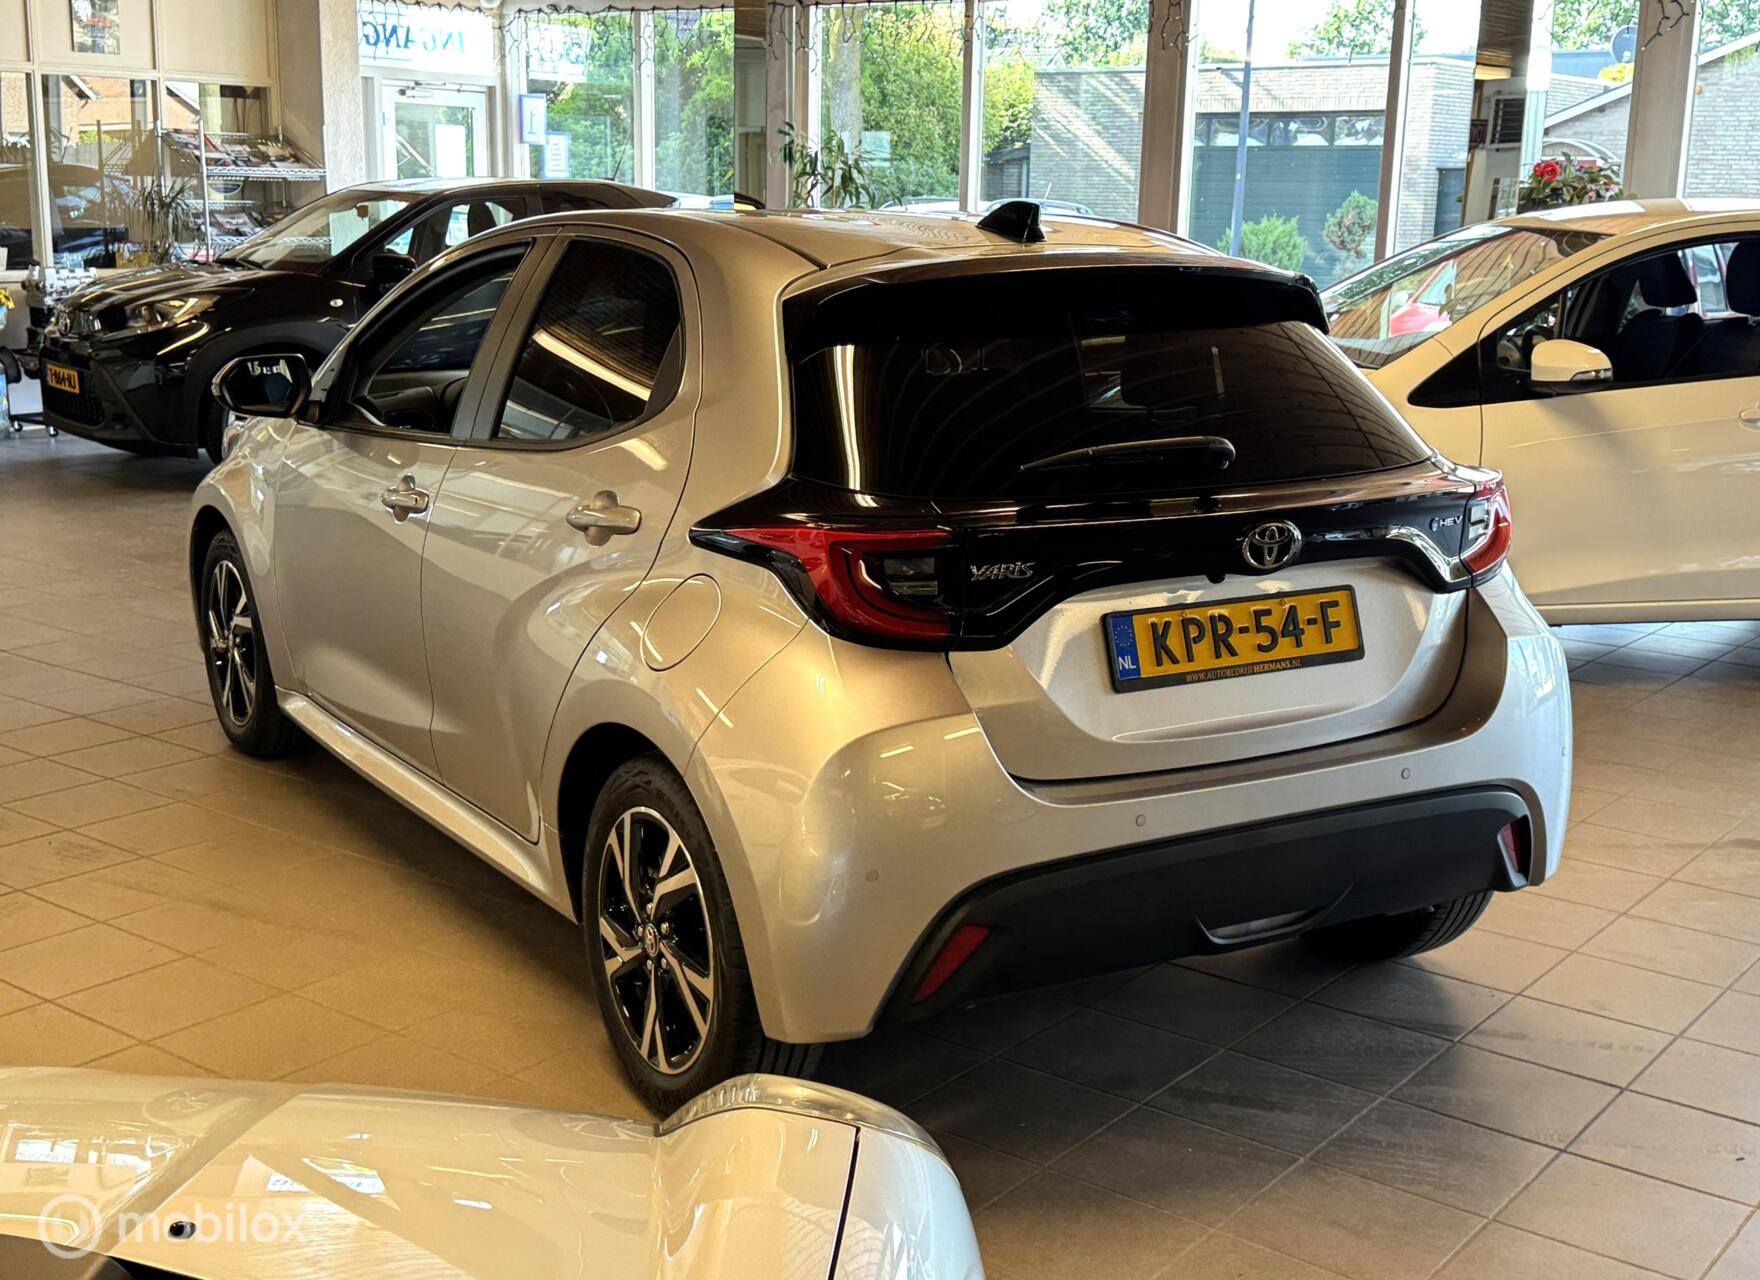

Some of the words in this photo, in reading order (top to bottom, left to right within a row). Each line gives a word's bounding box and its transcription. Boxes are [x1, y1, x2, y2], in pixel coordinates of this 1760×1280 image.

[1439, 515, 1463, 527] HEV
[970, 562, 1036, 581] YARIS
[1149, 600, 1342, 667] KPR-54-F
[1118, 656, 1136, 670] NL
